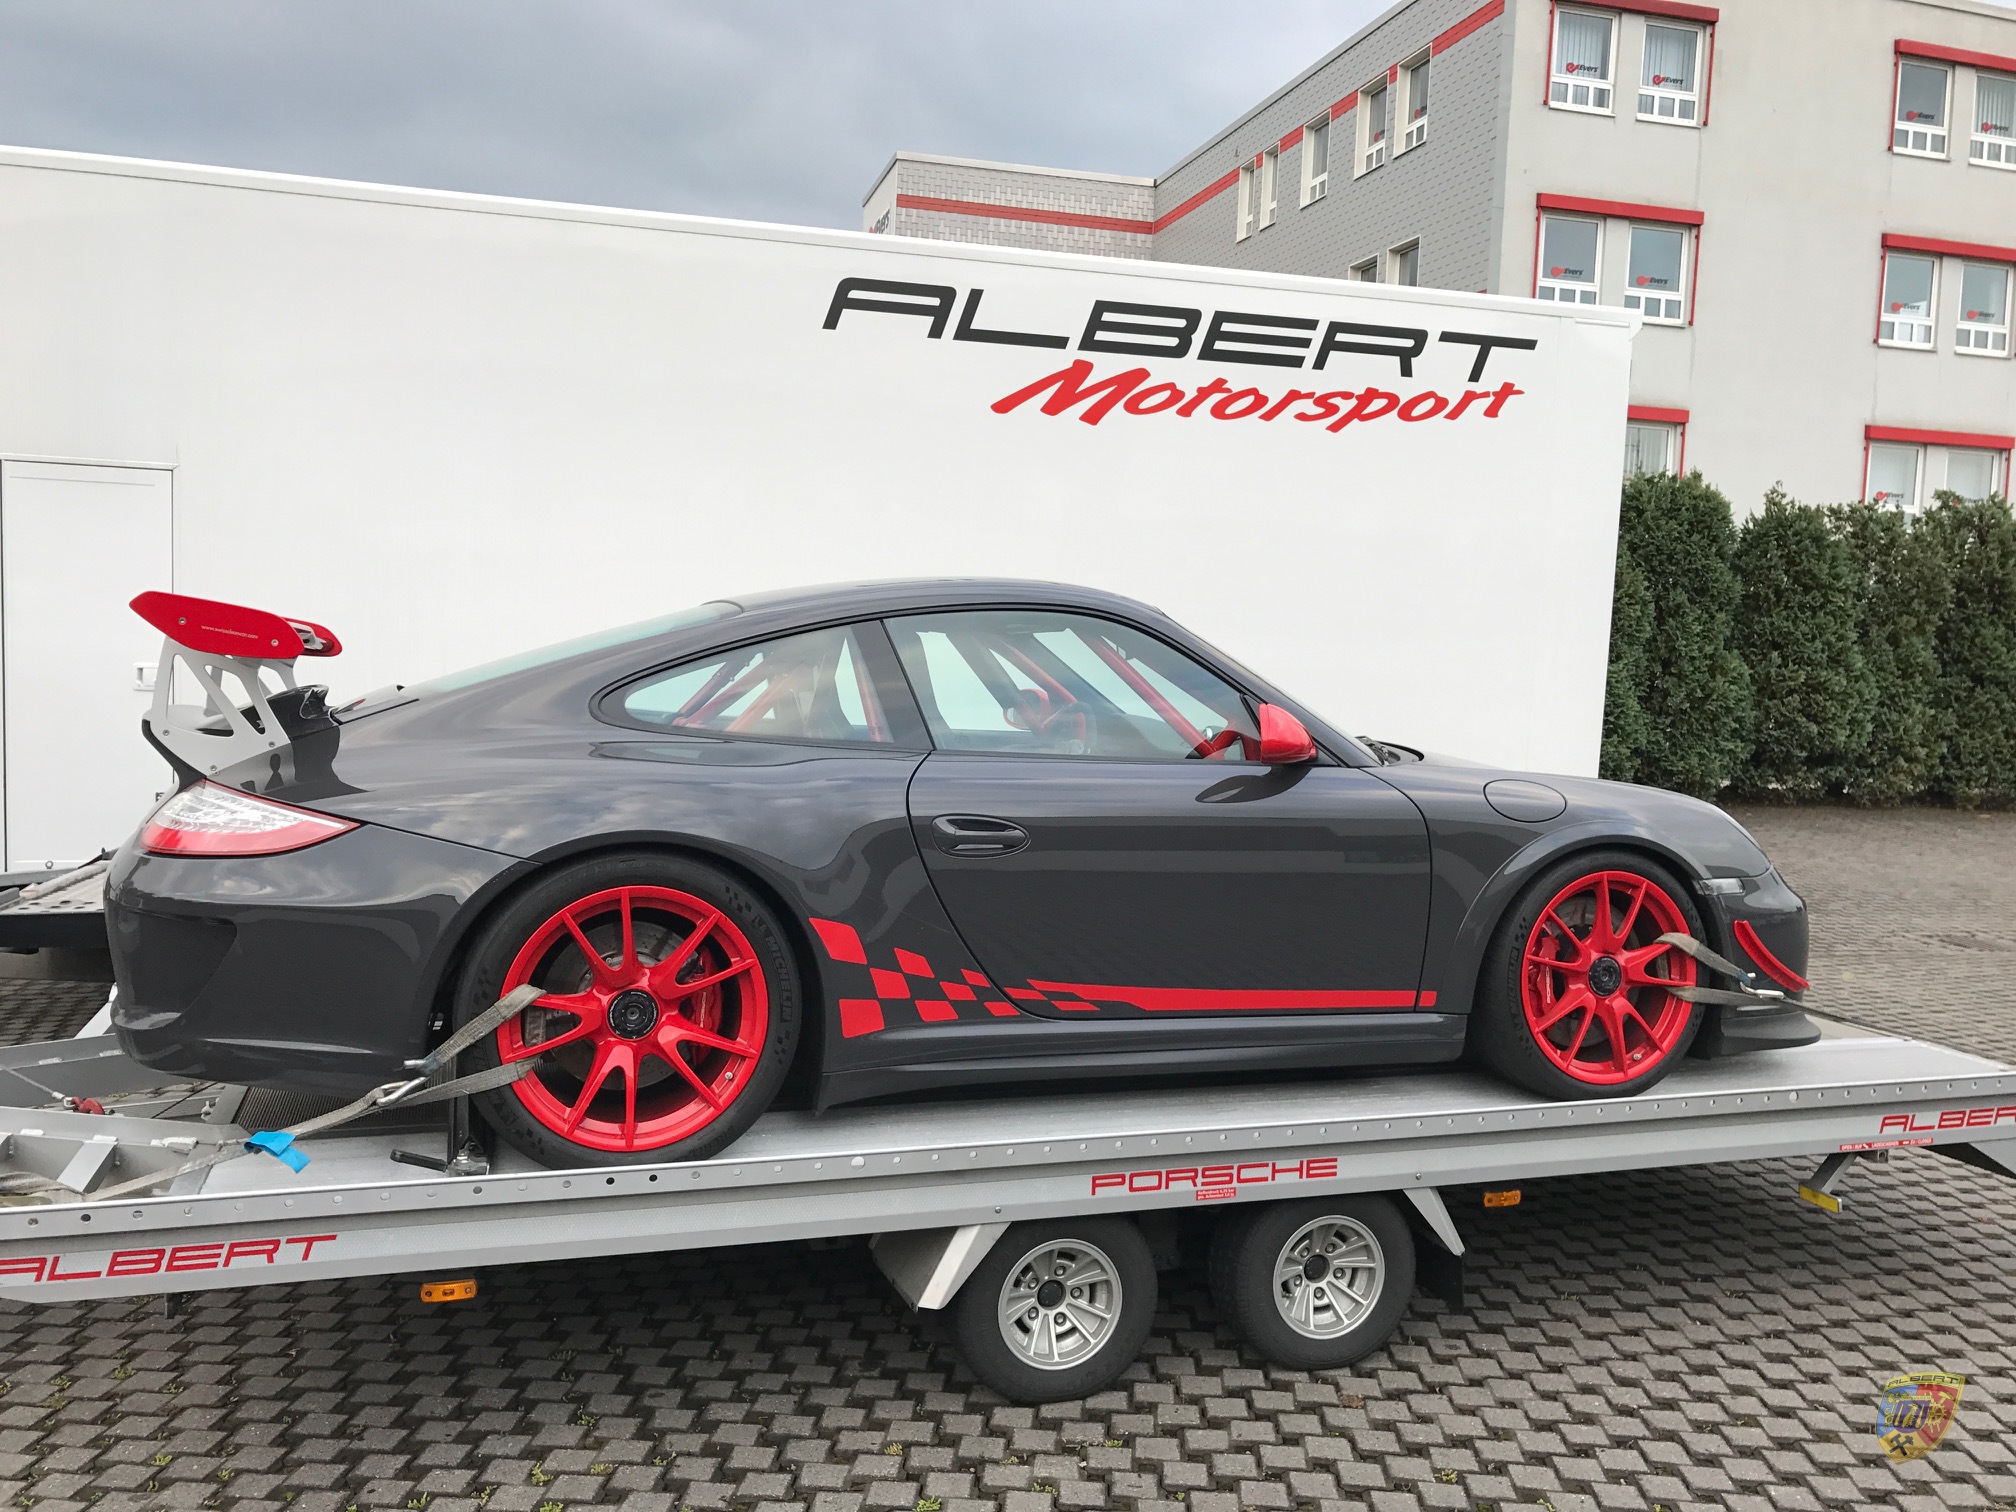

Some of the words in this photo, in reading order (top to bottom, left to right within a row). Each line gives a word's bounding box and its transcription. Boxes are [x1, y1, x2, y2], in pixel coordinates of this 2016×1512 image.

[1579, 64, 1598, 73] Evers
[1664, 76, 1684, 85] Evers
[822, 276, 1538, 383] ALBERT
[990, 358, 1526, 434] Motorsport
[1091, 1158, 1338, 1196] PORSCHE
[0, 1234, 337, 1283] ALBERT
